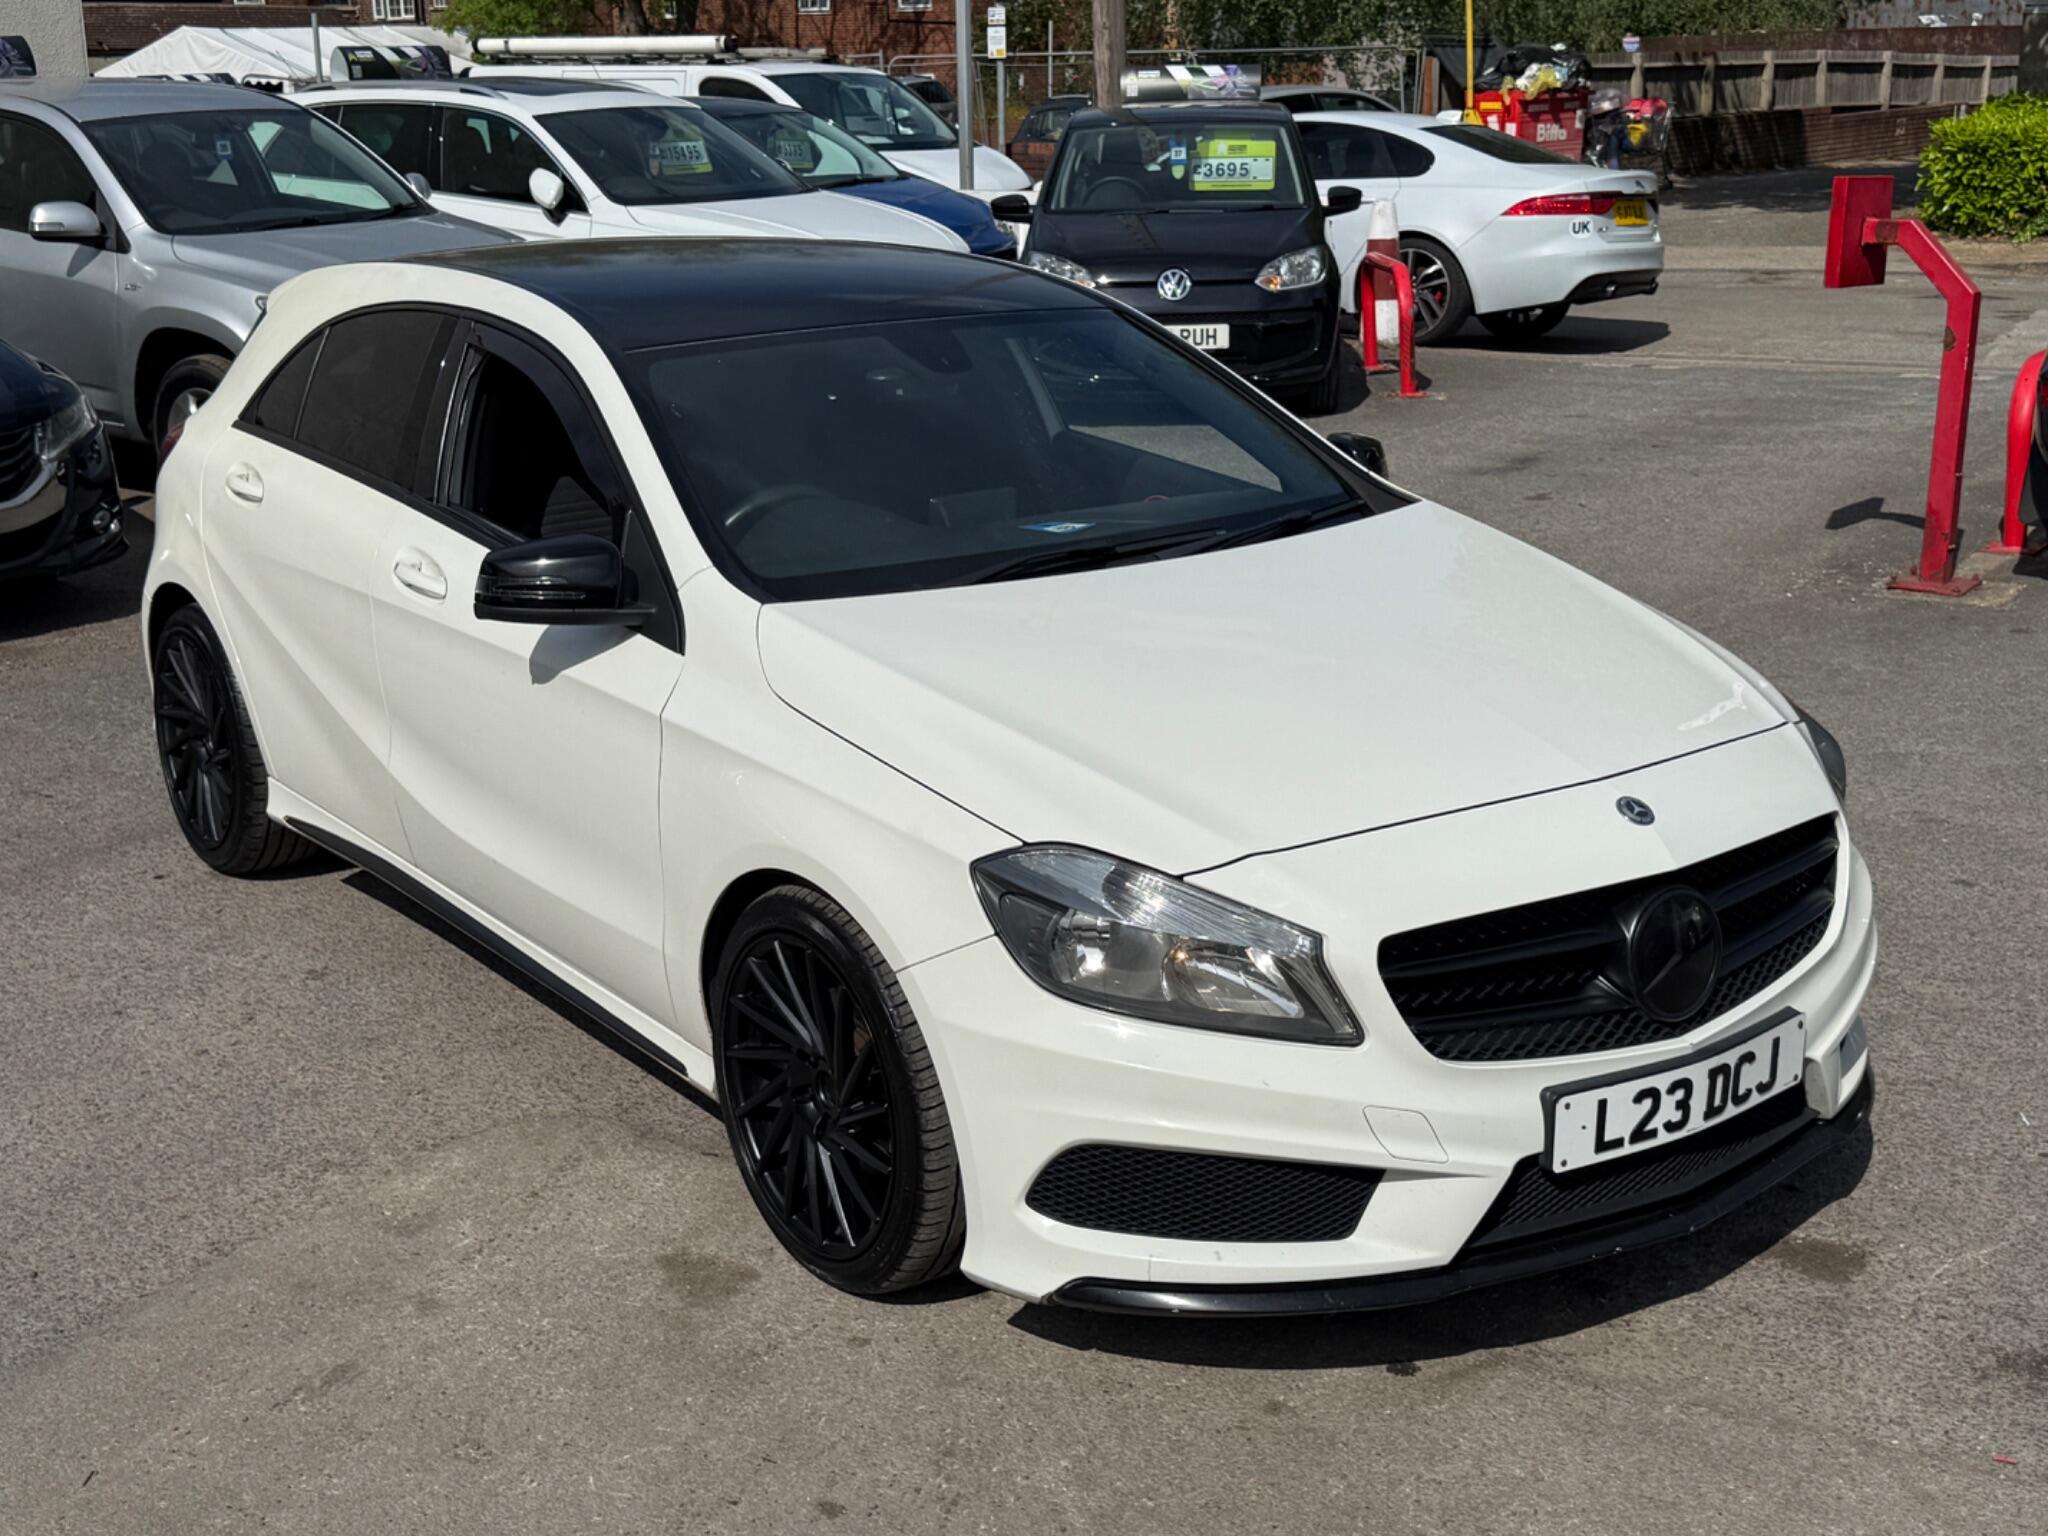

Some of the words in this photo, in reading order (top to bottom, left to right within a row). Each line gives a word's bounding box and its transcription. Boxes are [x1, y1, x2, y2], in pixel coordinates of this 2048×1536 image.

[1193, 162, 1250, 178] £3695
[1572, 221, 1591, 234] UK
[1594, 1076, 1693, 1155] L23
[1703, 1036, 1780, 1122] DCJ
